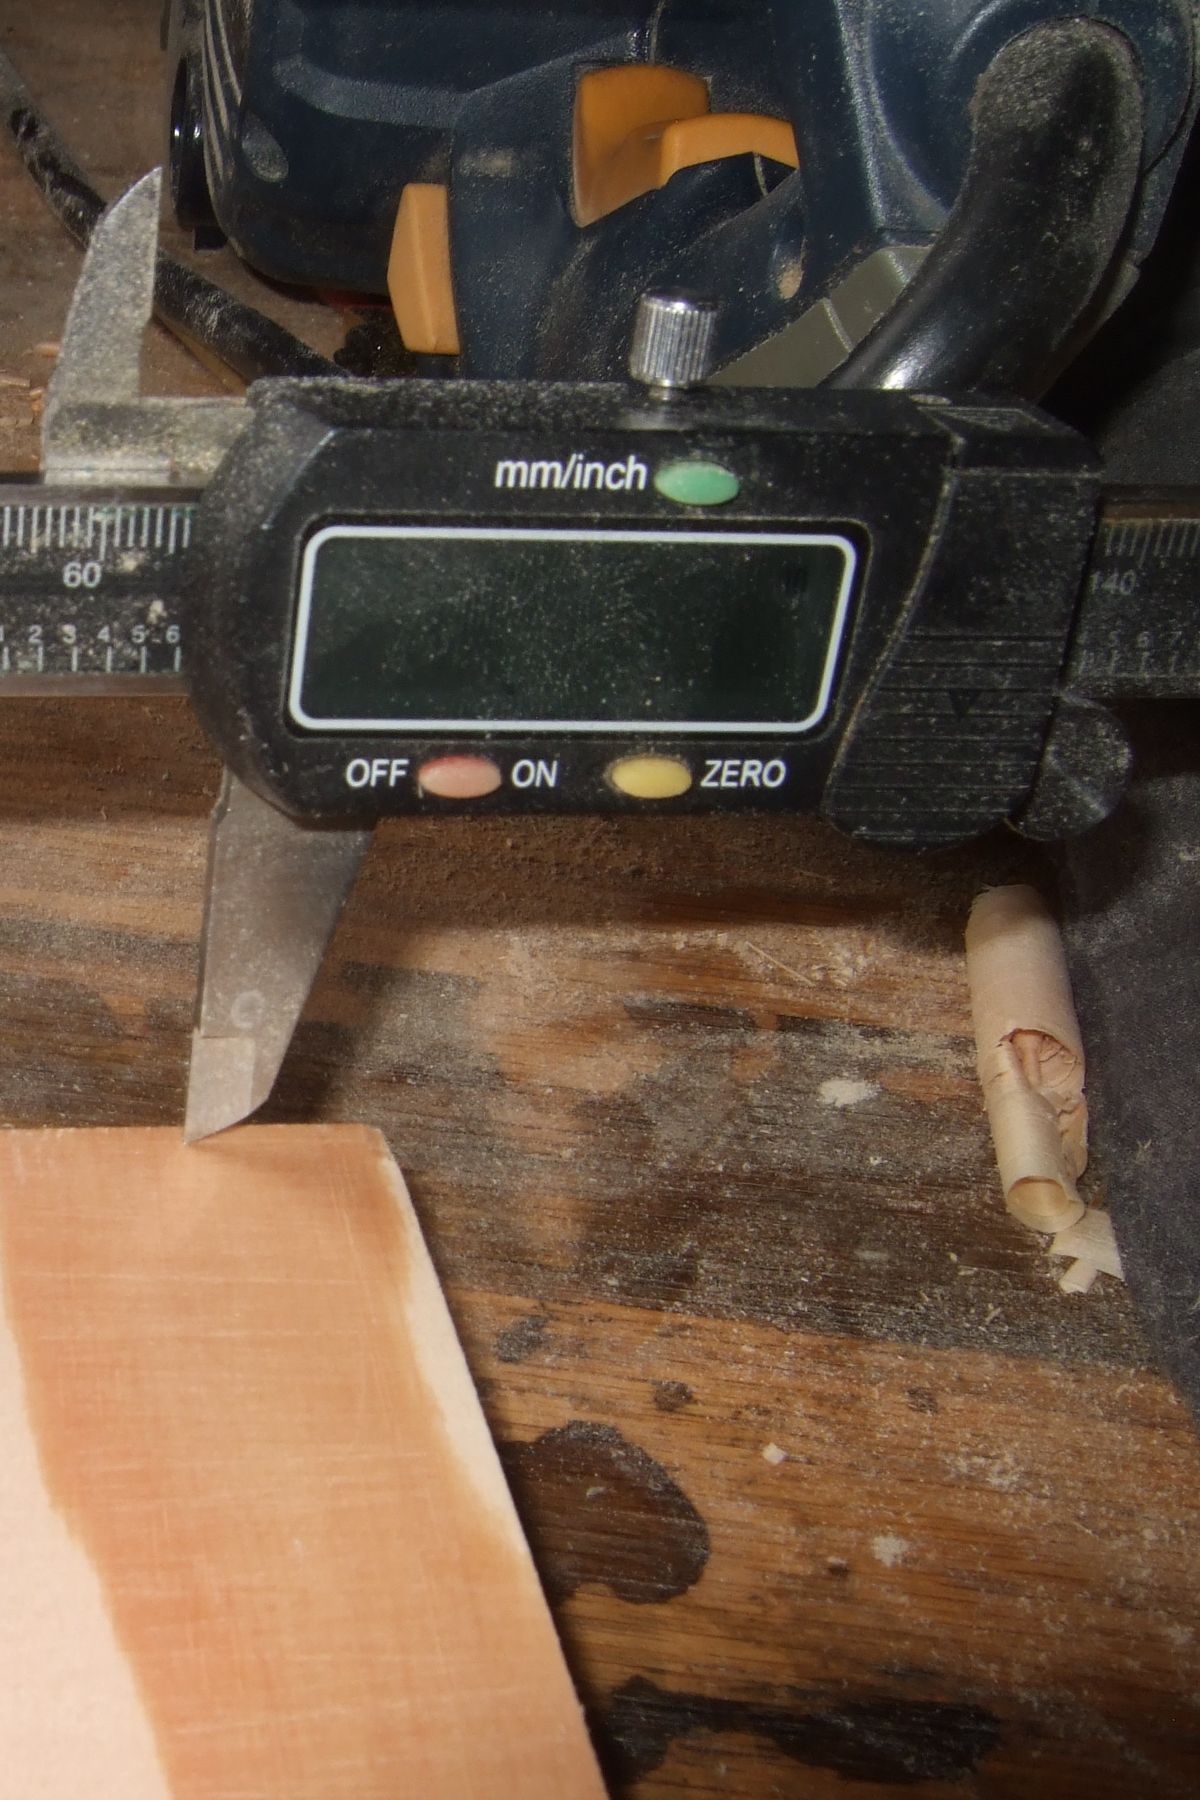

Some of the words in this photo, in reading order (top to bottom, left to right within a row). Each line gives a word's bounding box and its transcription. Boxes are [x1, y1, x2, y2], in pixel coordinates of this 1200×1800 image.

[494, 452, 649, 490] mm/inch
[63, 560, 101, 589] 60
[28, 625, 43, 645] 2
[62, 625, 76, 645] 3
[99, 625, 112, 645] 4
[131, 625, 146, 644] 5
[166, 625, 181, 644] 6
[345, 758, 409, 788] OFF
[511, 760, 559, 788] ON
[699, 760, 787, 788] ZERO
